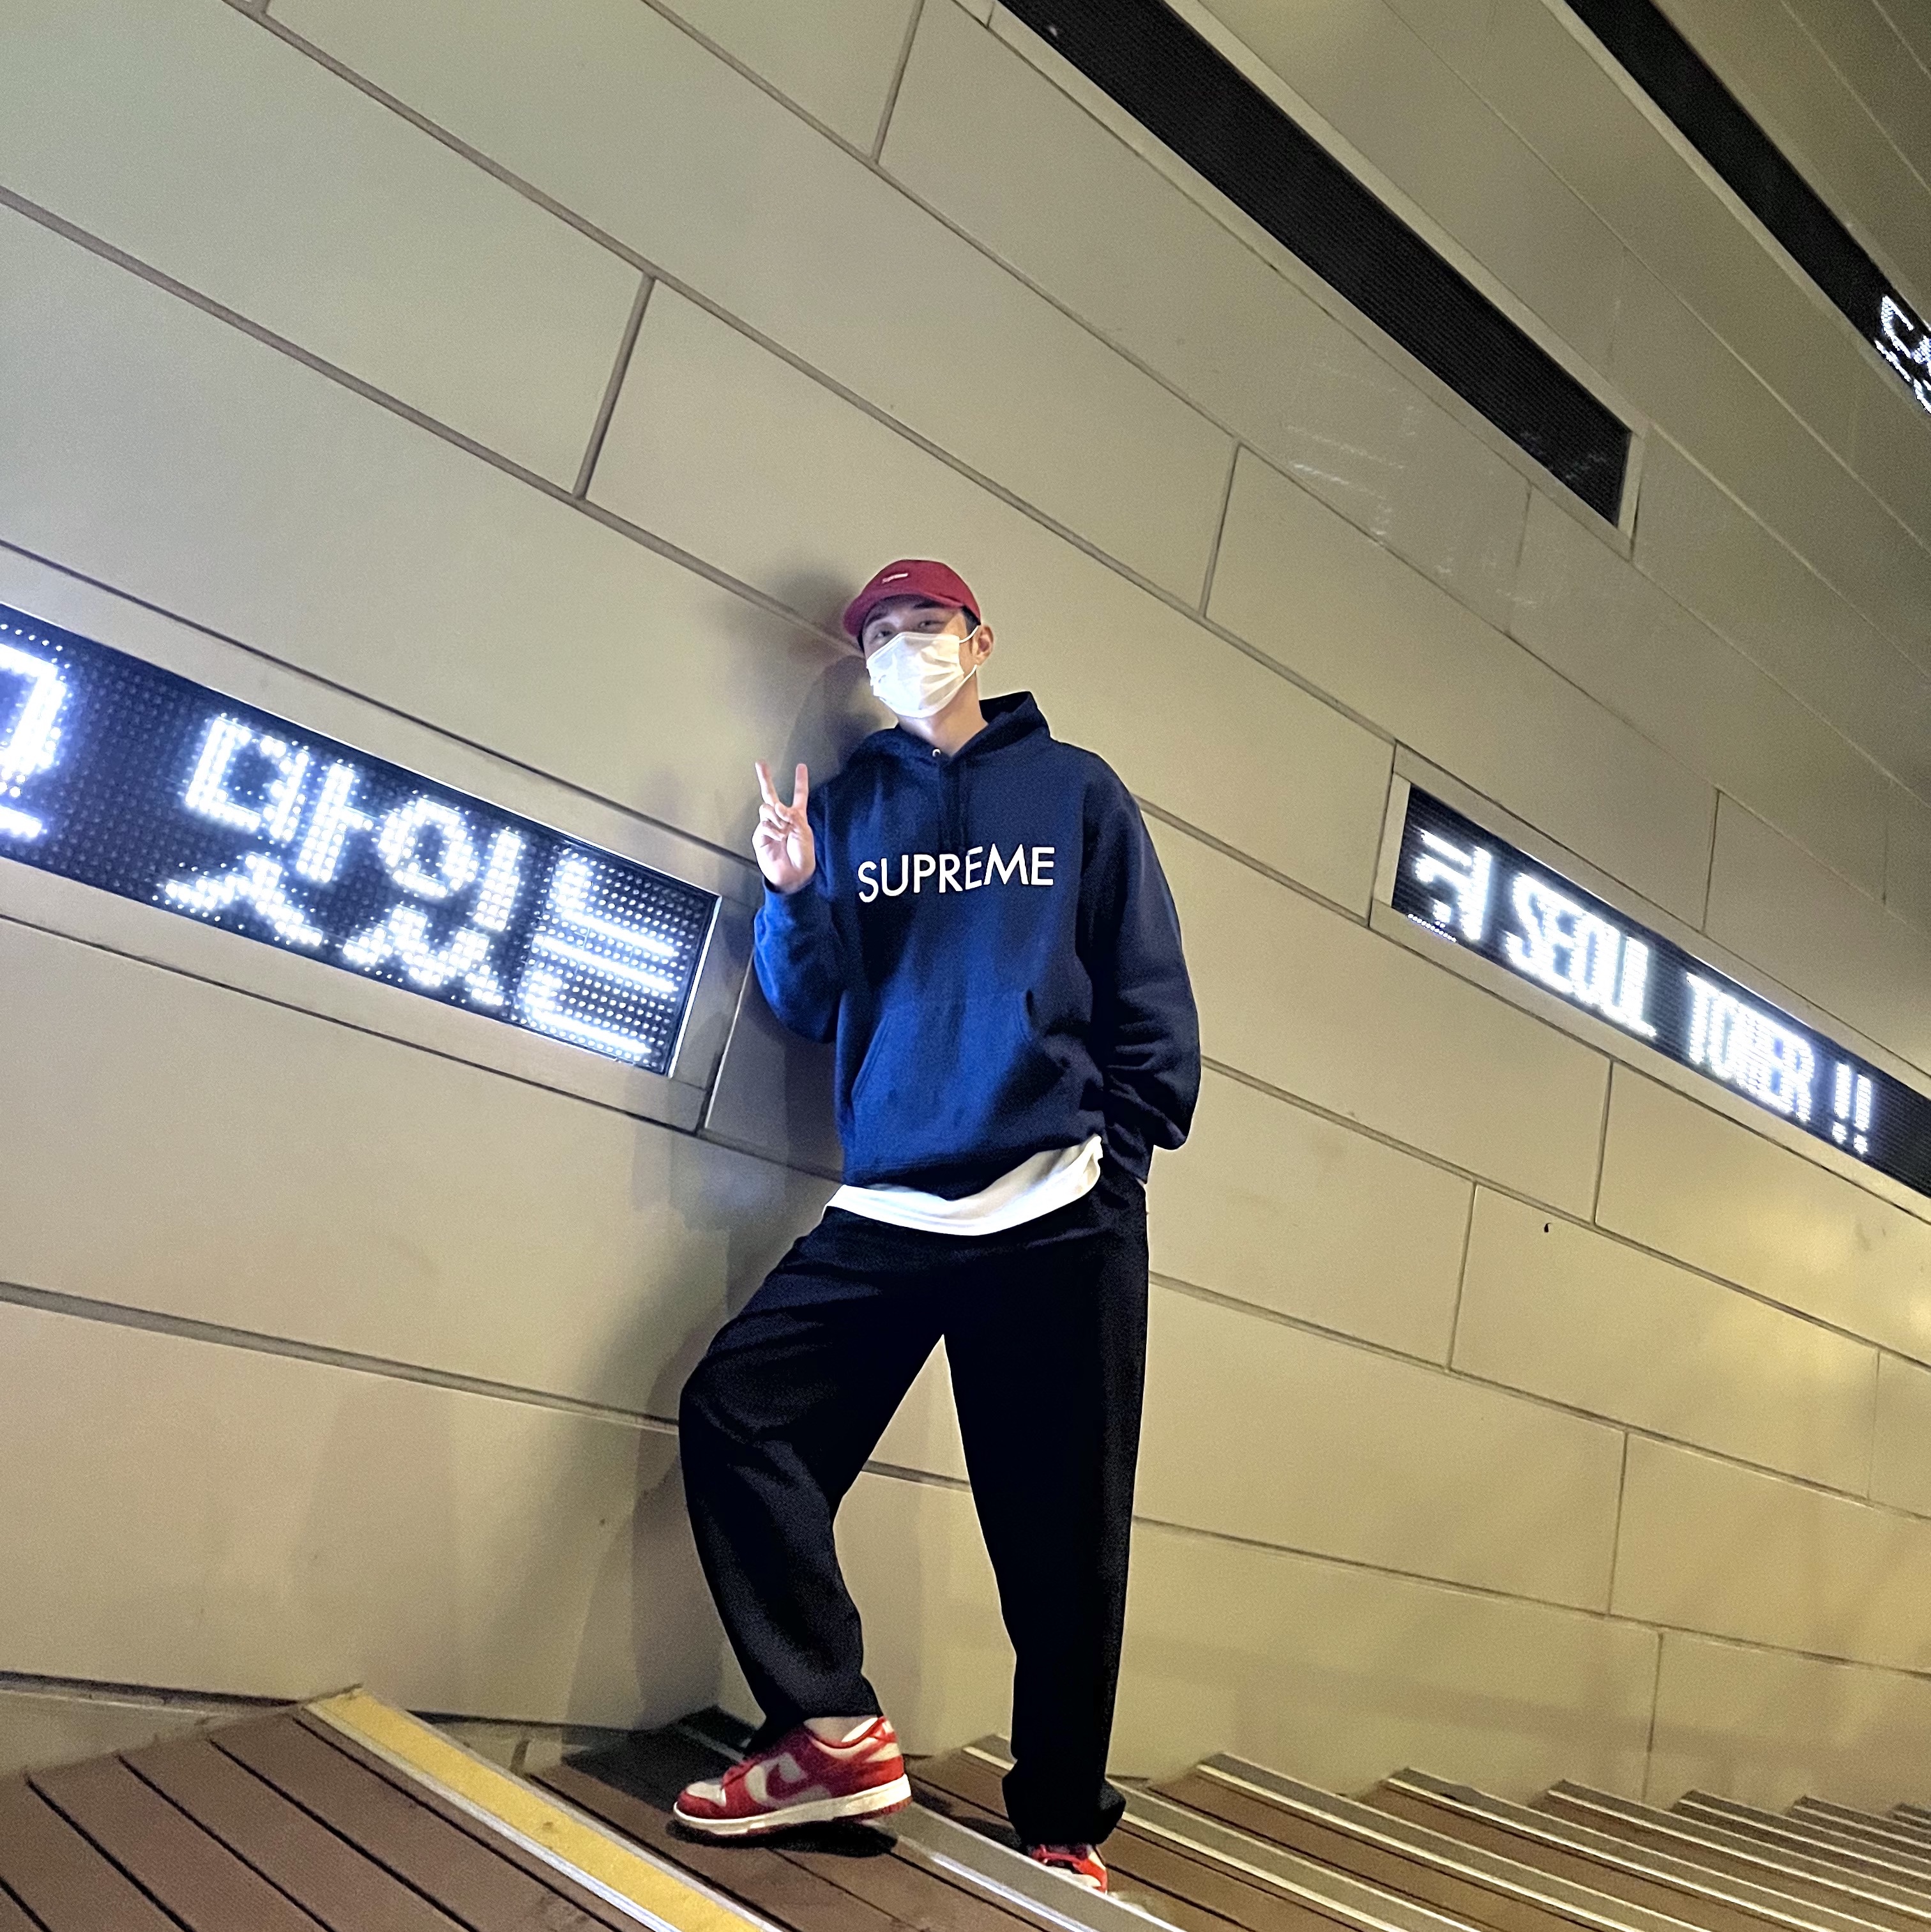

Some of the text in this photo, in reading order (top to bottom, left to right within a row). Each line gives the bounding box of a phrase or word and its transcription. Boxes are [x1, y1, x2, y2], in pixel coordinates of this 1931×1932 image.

[163, 713, 682, 1055] 맛있는
[858, 843, 1055, 902] SUPREME
[1505, 871, 1658, 1038] SEOUL
[1685, 970, 1816, 1122] TOWER
